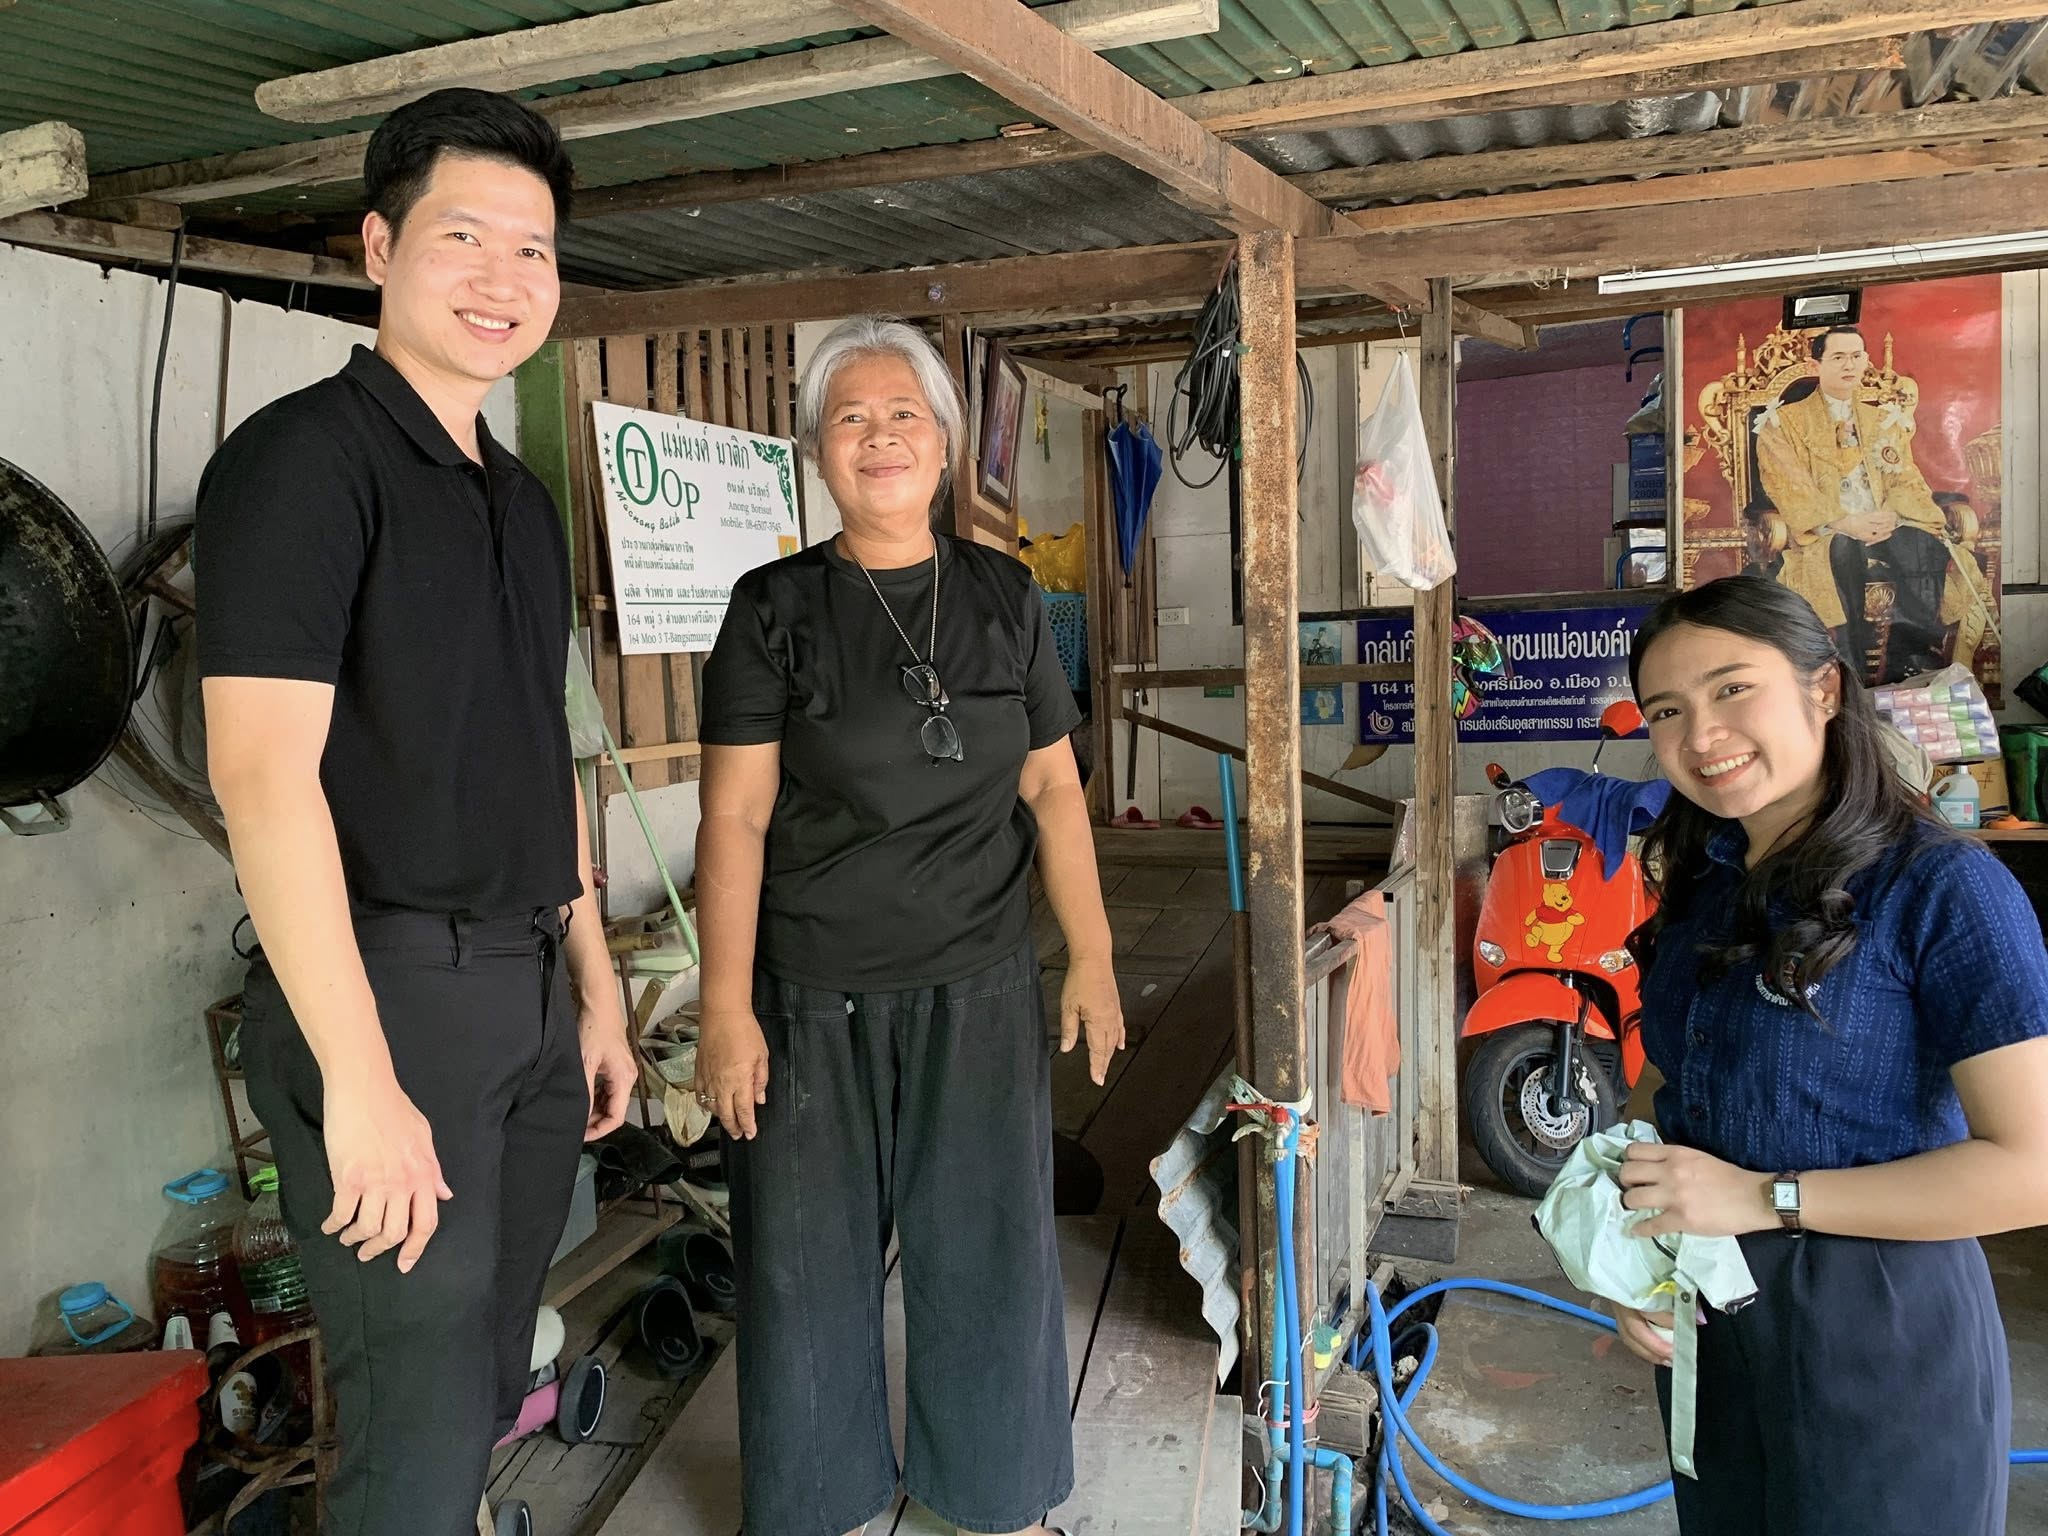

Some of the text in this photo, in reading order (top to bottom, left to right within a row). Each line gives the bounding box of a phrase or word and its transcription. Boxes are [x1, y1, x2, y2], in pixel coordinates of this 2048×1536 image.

[716, 435, 750, 470] บาติก
[660, 512, 681, 530] Batik
[627, 614, 641, 625] 164
[644, 611, 655, 629] หมู่
[658, 614, 663, 624] 3
[629, 634, 640, 646] 164
[641, 633, 656, 644] Moo
[658, 633, 663, 643] 3
[1371, 682, 1399, 695] 164
[1550, 673, 1600, 689] อ.เมือง
[1460, 715, 1573, 734] กรมส่งเสริมอุตสาหกรรม
